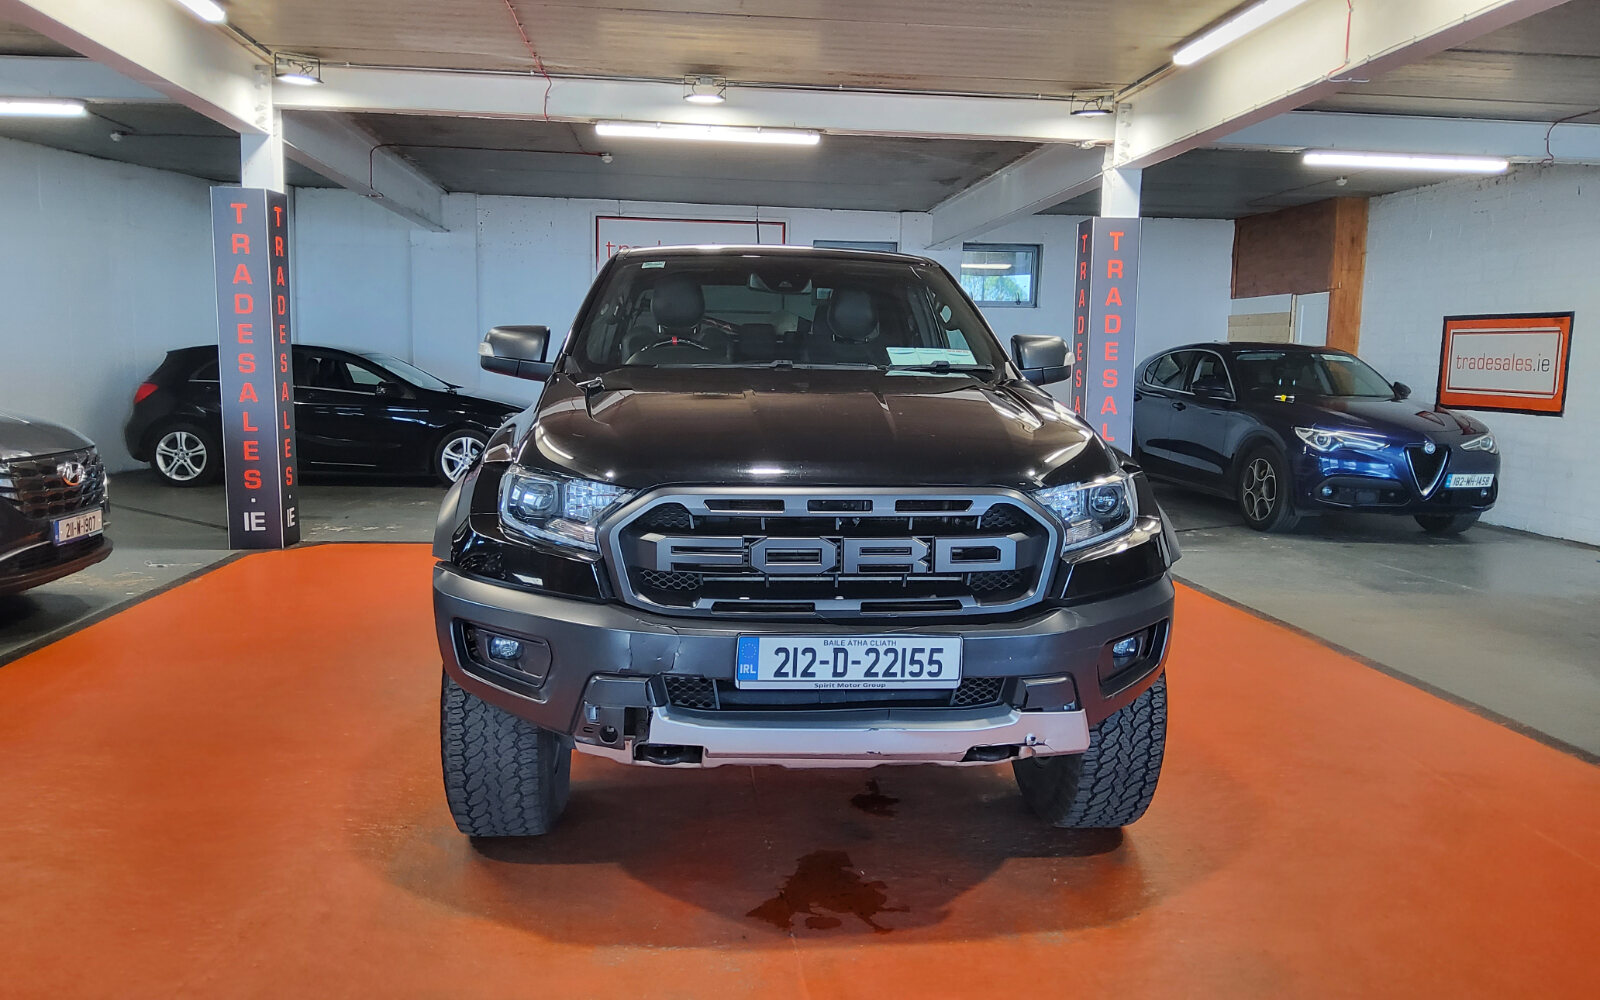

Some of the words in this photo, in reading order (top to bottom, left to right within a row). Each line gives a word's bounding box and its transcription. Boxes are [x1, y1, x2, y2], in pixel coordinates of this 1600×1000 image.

[1074, 234, 1088, 414] TRADESA
[1100, 231, 1125, 442] TRADESAL
[1456, 353, 1550, 373] tradesales.ie
[652, 535, 1019, 574] FORD
[823, 639, 846, 647] BAILE
[847, 639, 869, 647] ATHA
[869, 639, 897, 647] CLIATH
[739, 664, 757, 674] IRL
[773, 647, 944, 678] 212-D-22155
